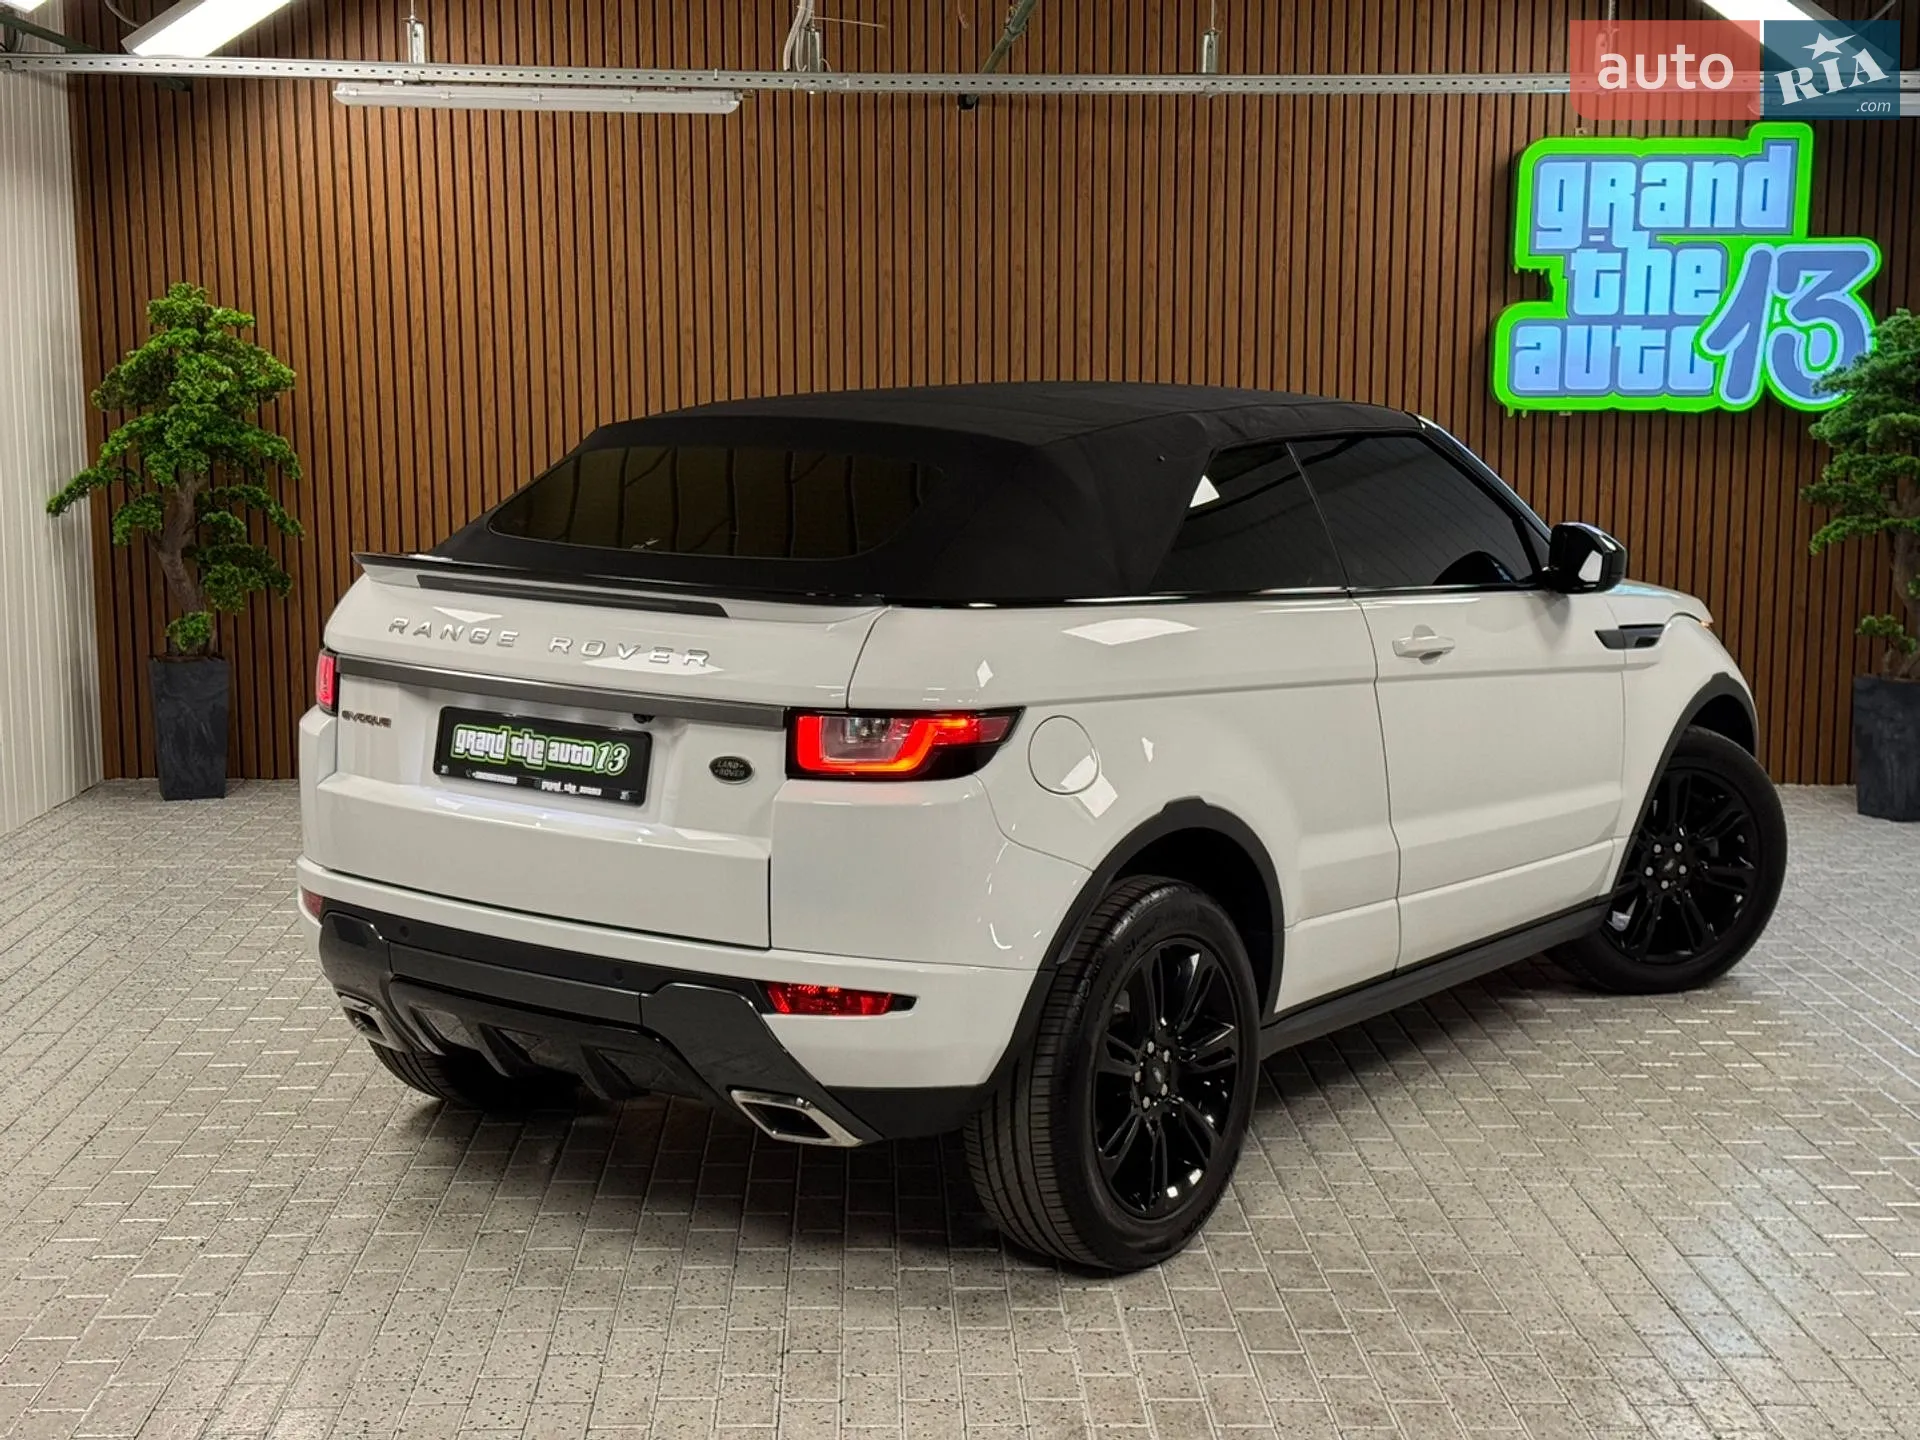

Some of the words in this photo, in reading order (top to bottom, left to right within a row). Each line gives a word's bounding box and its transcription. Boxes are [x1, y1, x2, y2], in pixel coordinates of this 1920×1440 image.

[1571, 232, 1723, 316] the
[1701, 243, 1874, 405] 13
[388, 617, 518, 648] RANGE
[549, 636, 710, 667] ROVER
[342, 710, 392, 729] EVOQUE
[510, 733, 546, 765] the
